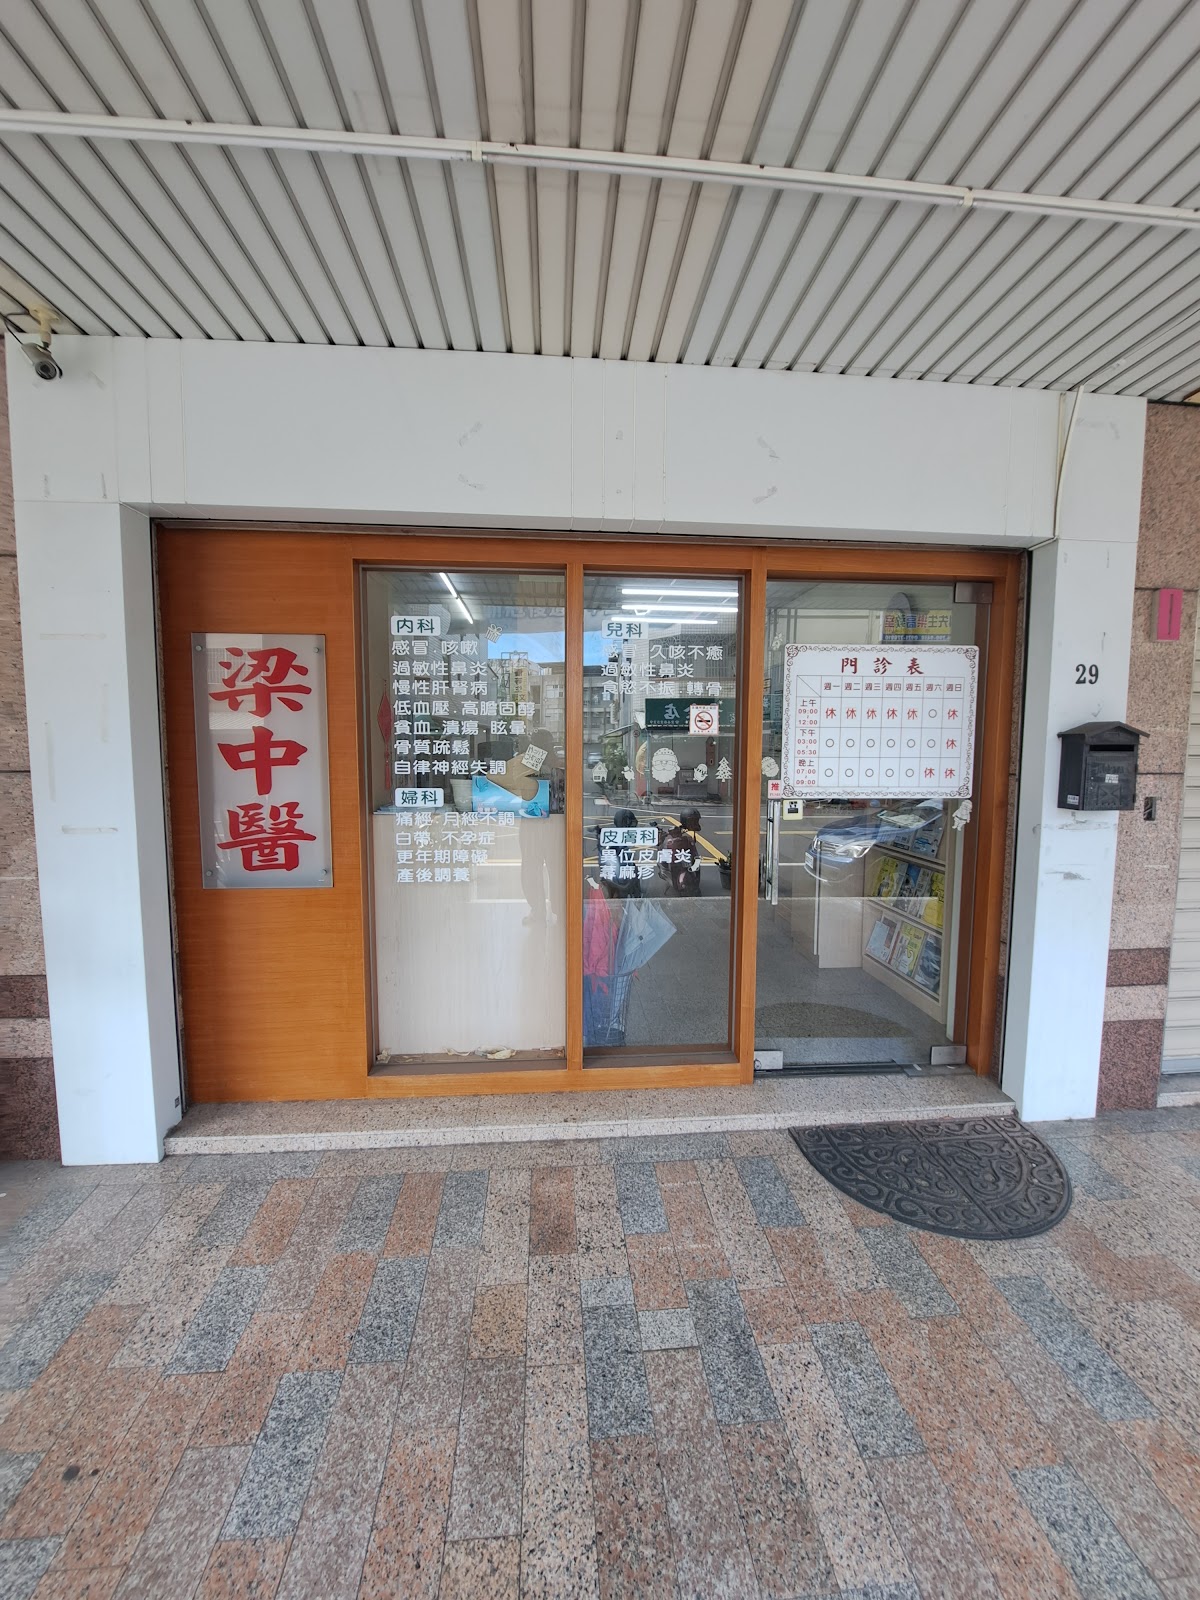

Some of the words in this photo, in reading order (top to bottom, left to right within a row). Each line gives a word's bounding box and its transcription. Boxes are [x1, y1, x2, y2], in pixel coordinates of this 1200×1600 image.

[606, 622, 642, 638] 兒科
[393, 661, 488, 676] 過敏性鼻炎
[600, 662, 694, 678] 過敏性鼻炎
[841, 657, 924, 675] 門診表
[1075, 664, 1099, 684] 29
[393, 680, 488, 696] 慢性肝腎病
[824, 682, 840, 692] 週一
[844, 682, 860, 692] 週二
[865, 682, 881, 692] 週三
[886, 682, 902, 692] 週四
[906, 682, 922, 692] 週五
[926, 682, 942, 692] 週六
[946, 682, 962, 692] 週日
[800, 699, 816, 707] 上午
[826, 708, 836, 718] 休
[846, 708, 857, 719] 休
[866, 708, 877, 719] 休
[887, 709, 898, 719] 休
[907, 709, 918, 719] 休
[948, 709, 958, 720] 休
[800, 729, 816, 737] 下午
[394, 740, 470, 755] 骨質疏鬆
[946, 738, 957, 749] 休
[208, 648, 316, 872] 梁中醫
[394, 760, 507, 775] 自律神經失調
[798, 759, 815, 767] 晚上
[924, 768, 935, 777] 休
[944, 768, 956, 778] 休
[401, 790, 438, 805] 婦科
[602, 830, 656, 844] 皮膚科
[396, 850, 488, 864] 更年期障礙
[600, 848, 692, 864] 異位皮膚炎
[397, 867, 470, 883] 產後調養
[600, 864, 655, 880] 蕁麻疹
